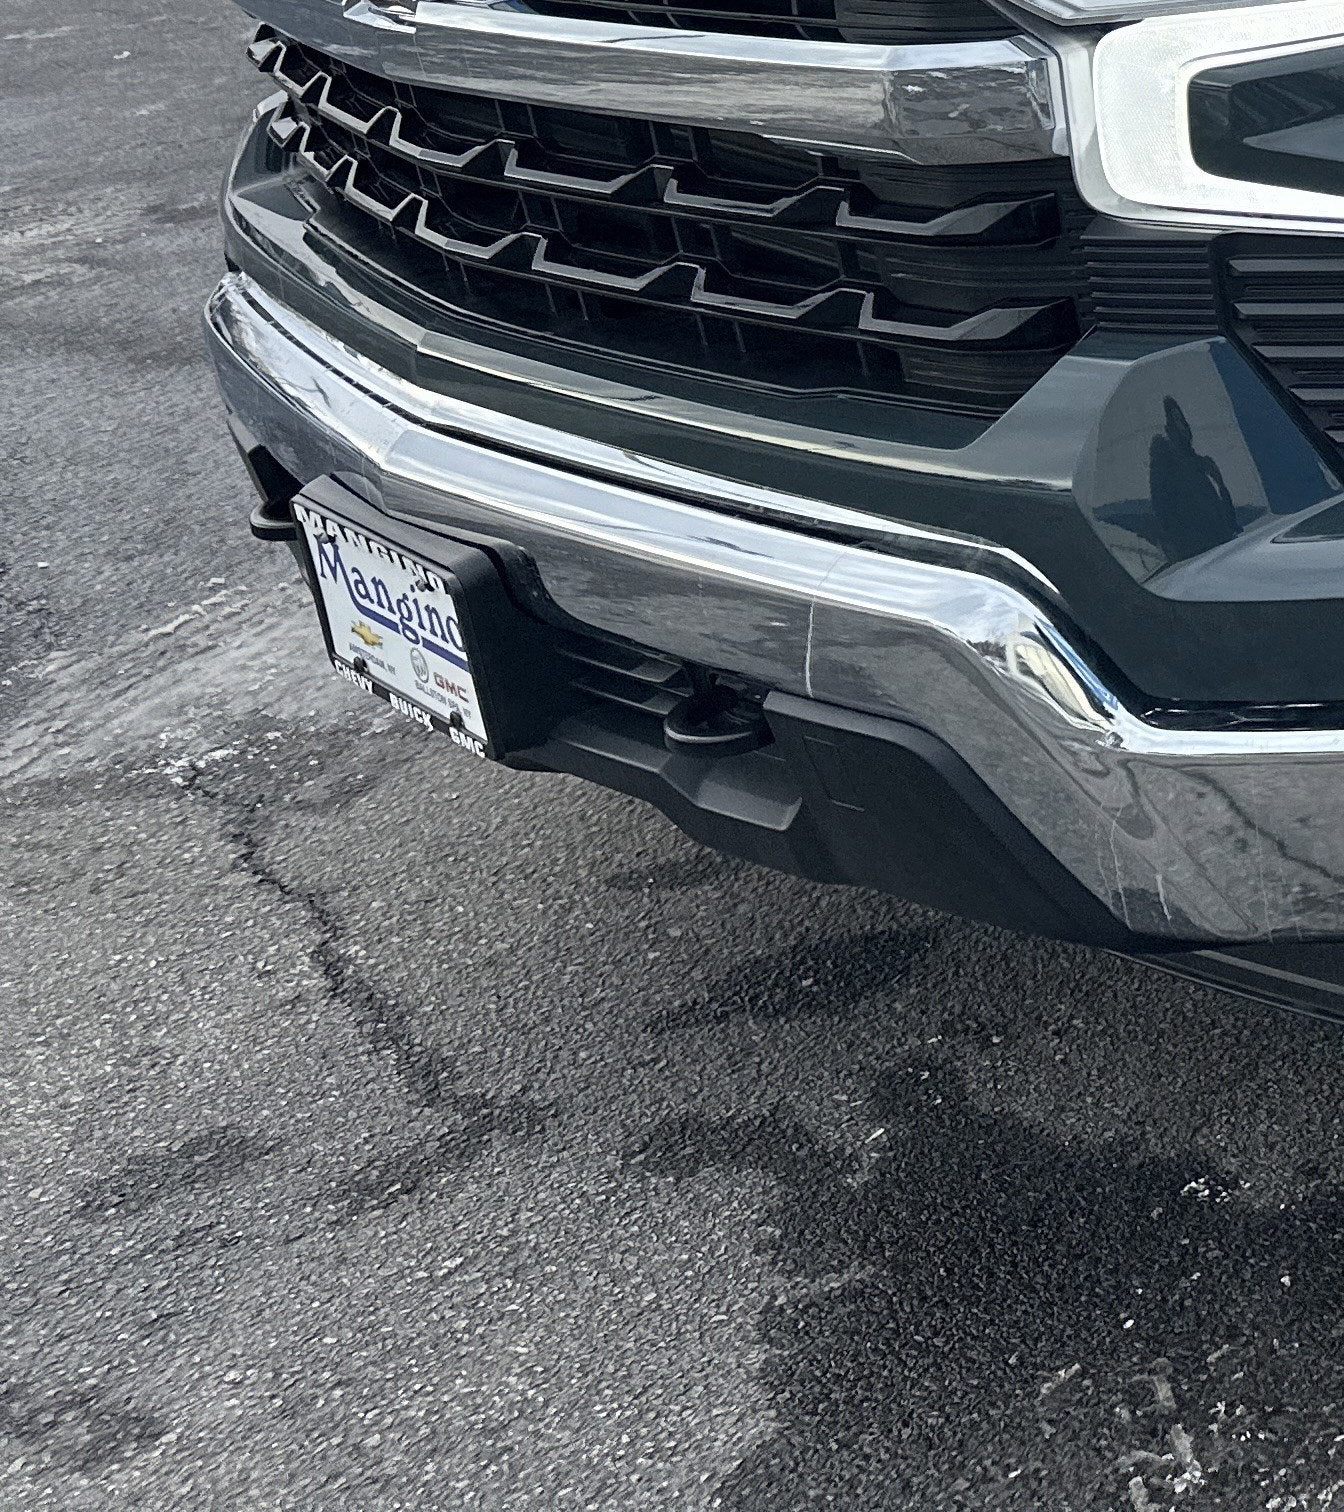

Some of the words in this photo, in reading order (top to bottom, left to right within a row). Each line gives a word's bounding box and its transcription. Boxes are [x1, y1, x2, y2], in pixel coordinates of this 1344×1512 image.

[293, 503, 448, 594] MANGINO
[312, 533, 466, 655] Mangino
[334, 659, 373, 694] CHEVY
[389, 692, 434, 732] BUICK
[448, 727, 486, 759] GMC
[433, 671, 469, 703] GMC
